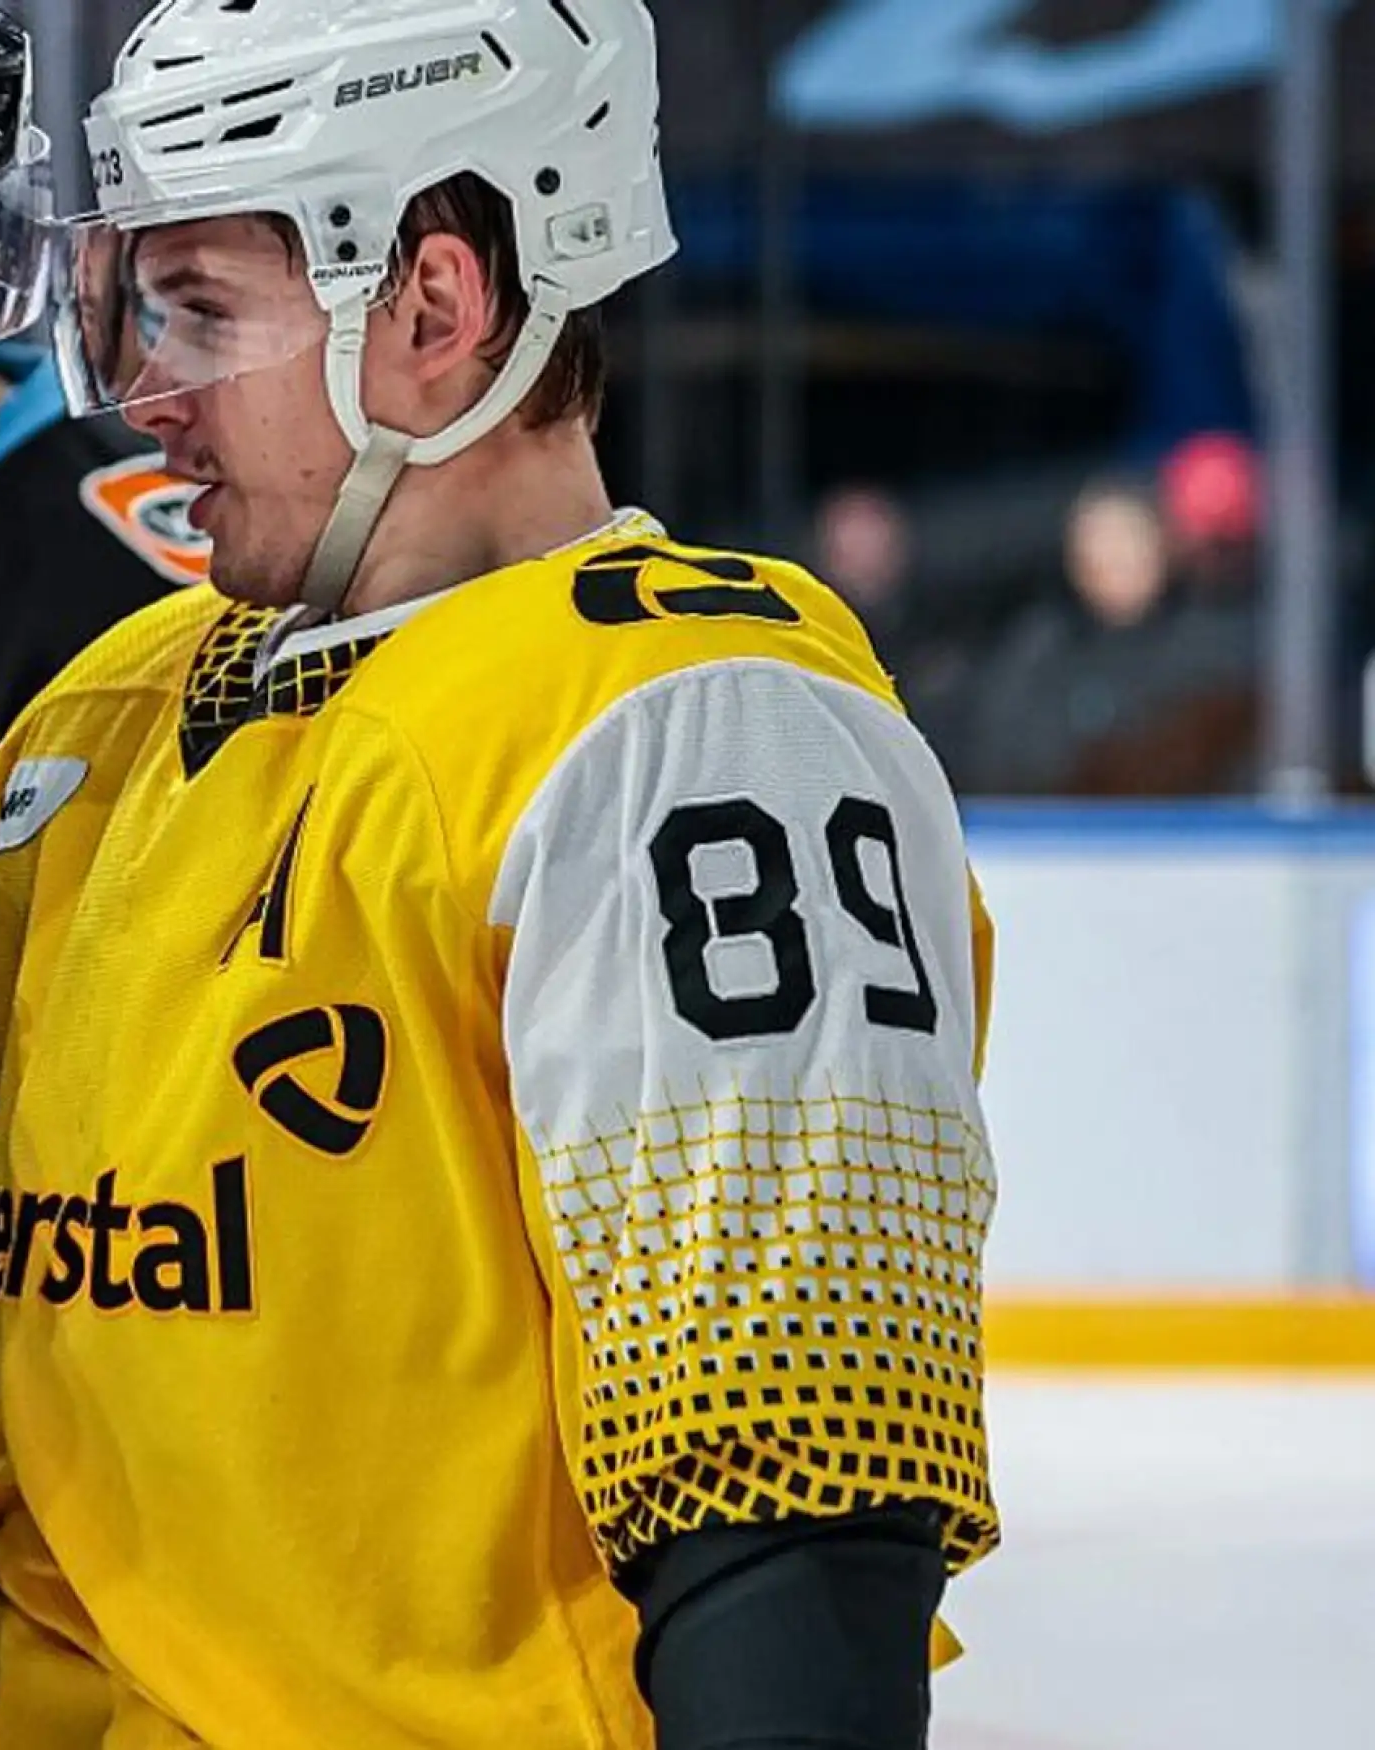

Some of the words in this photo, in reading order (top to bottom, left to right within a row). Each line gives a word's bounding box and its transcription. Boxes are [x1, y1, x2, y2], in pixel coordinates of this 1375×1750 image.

[333, 52, 482, 108] BAUER
[217, 783, 314, 968] A
[649, 797, 937, 1041] 89
